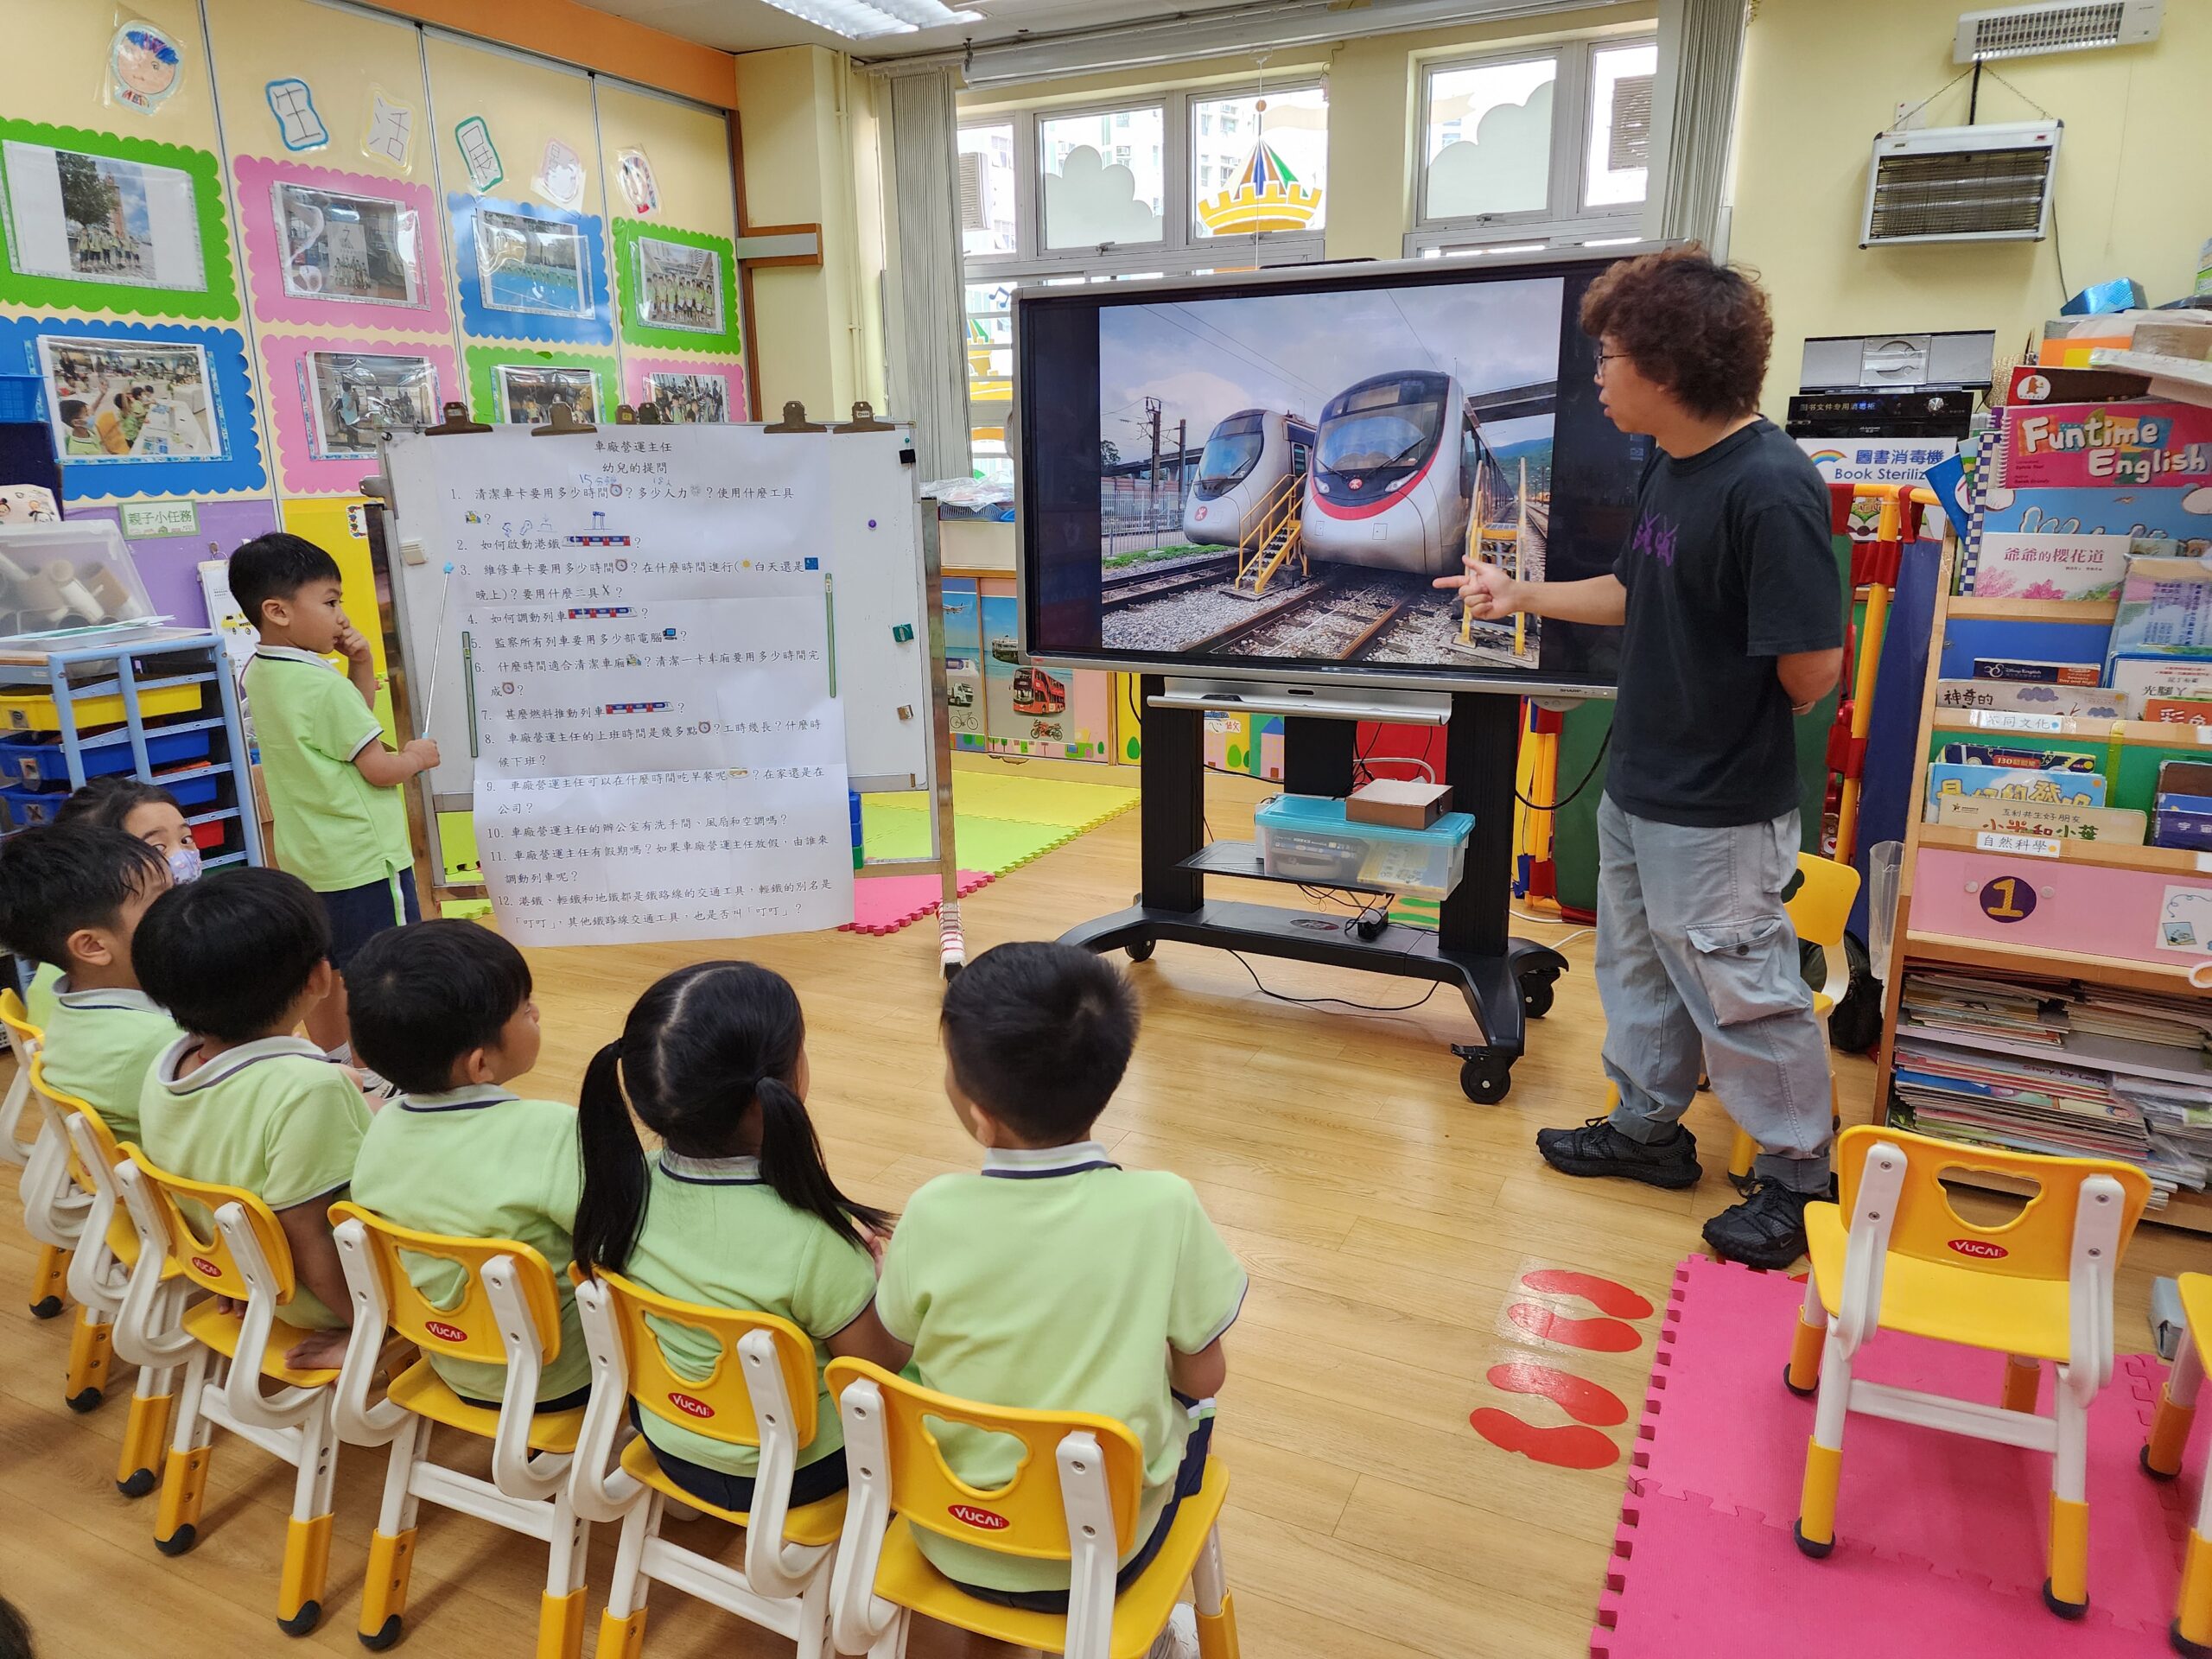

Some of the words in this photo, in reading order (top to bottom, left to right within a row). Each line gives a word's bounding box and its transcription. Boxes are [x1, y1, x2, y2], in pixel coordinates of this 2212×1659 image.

[2022, 416, 2158, 453] Funtime
[594, 441, 672, 453] 車廠營運主任
[1855, 449, 1944, 465] 圖書消毒機
[2088, 444, 2208, 484] English
[602, 462, 667, 474] 幼兒的提問
[1835, 468, 1873, 480] Book
[452, 489, 461, 499] 1.
[475, 487, 608, 499] 清潔車卡要用多少時間
[127, 510, 192, 524] 親子小任務
[457, 540, 467, 550] 2.
[2004, 547, 2104, 563] 爺爺的櫻花道
[461, 564, 471, 575] 3.
[484, 563, 614, 575] 維修車卡要用多少時間
[754, 561, 804, 572] 白天還是
[467, 615, 478, 624] 4.
[491, 612, 567, 624] 如何調動列車
[471, 638, 481, 648] 5.
[494, 633, 663, 648] 監察所有列車要用多少部電腦
[474, 662, 485, 672] 6.
[498, 657, 626, 672] 什麼時間適合清潔車廂
[491, 687, 502, 697] 成
[1944, 689, 1993, 706] 神奇的
[481, 710, 492, 721] 7.
[505, 707, 605, 720] 甚麼燃料推動列車
[1988, 715, 2050, 729] 不同文化
[485, 734, 494, 744] 8.
[508, 728, 697, 744] 車廠營運主任的上班時間是幾多點
[499, 755, 546, 767] 候下班？
[486, 782, 496, 791] 9.
[511, 772, 728, 791] 車廠營運主任可以在什麼時間吃早餐呢
[498, 803, 533, 815] 公司？
[2002, 809, 2081, 823] 互利共生好朋友
[487, 828, 504, 838] 10.
[1984, 836, 2048, 853] 自然科學
[491, 851, 507, 861] 11.
[505, 871, 578, 884] 調動列車呢？
[499, 896, 513, 906] 12.
[1987, 878, 2024, 918] 1
[2023, 1065, 2055, 1074] Story
